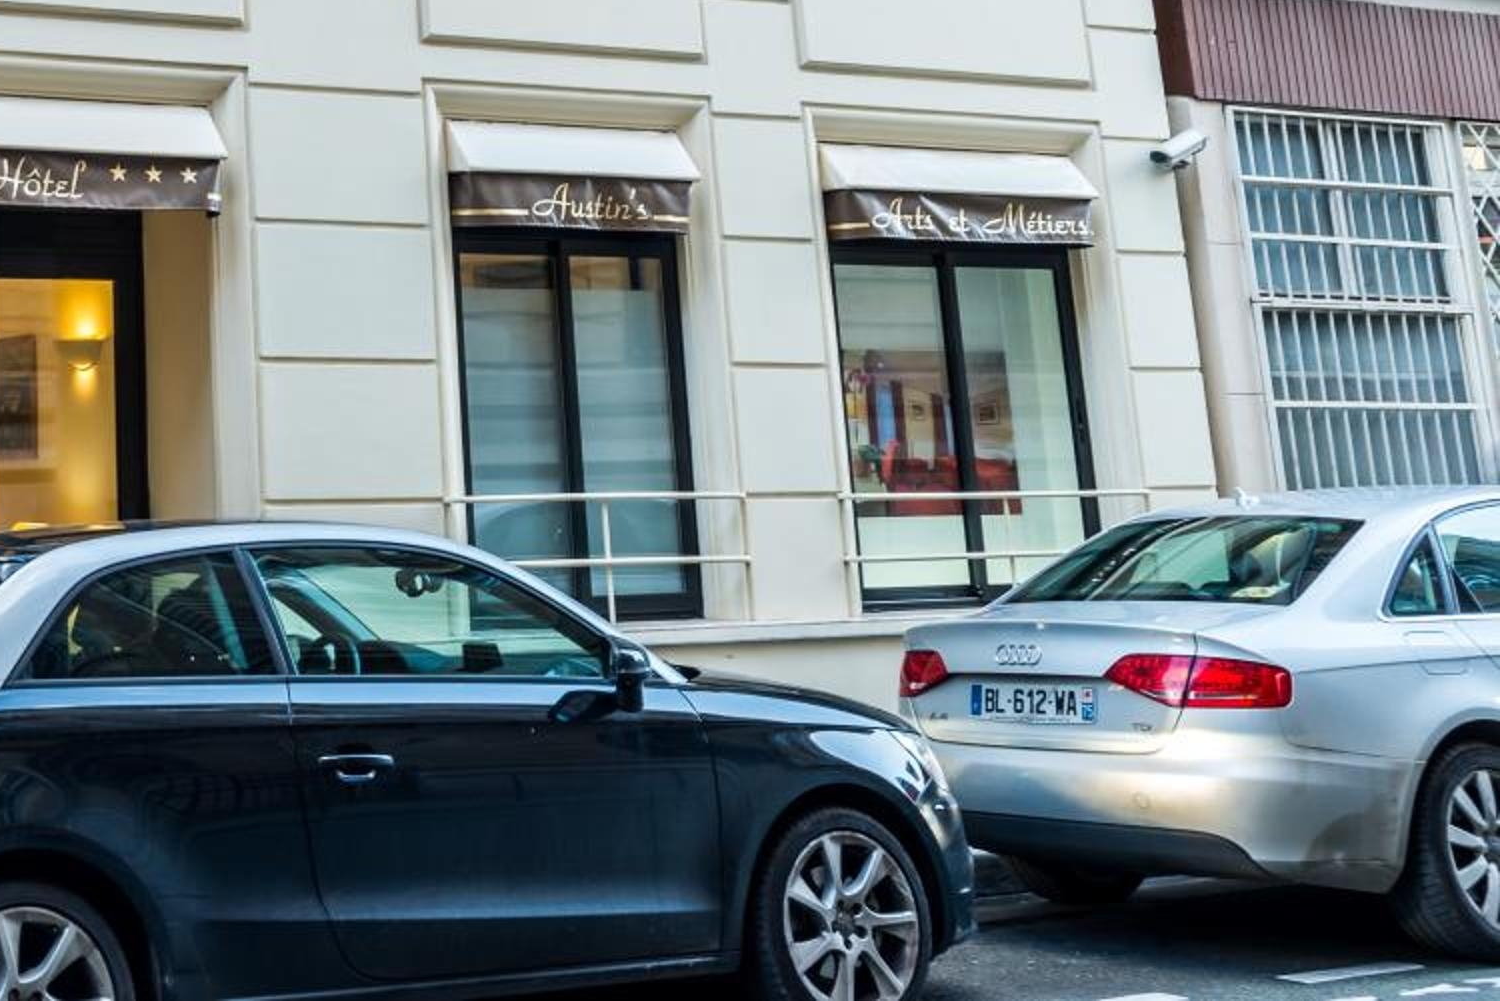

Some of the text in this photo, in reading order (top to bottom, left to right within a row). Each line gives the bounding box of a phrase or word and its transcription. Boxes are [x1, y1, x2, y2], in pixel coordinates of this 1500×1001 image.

[531, 182, 650, 221] Austin's
[871, 197, 1090, 239] Arts et Métiers
[984, 687, 1077, 716] BL-612-WA
